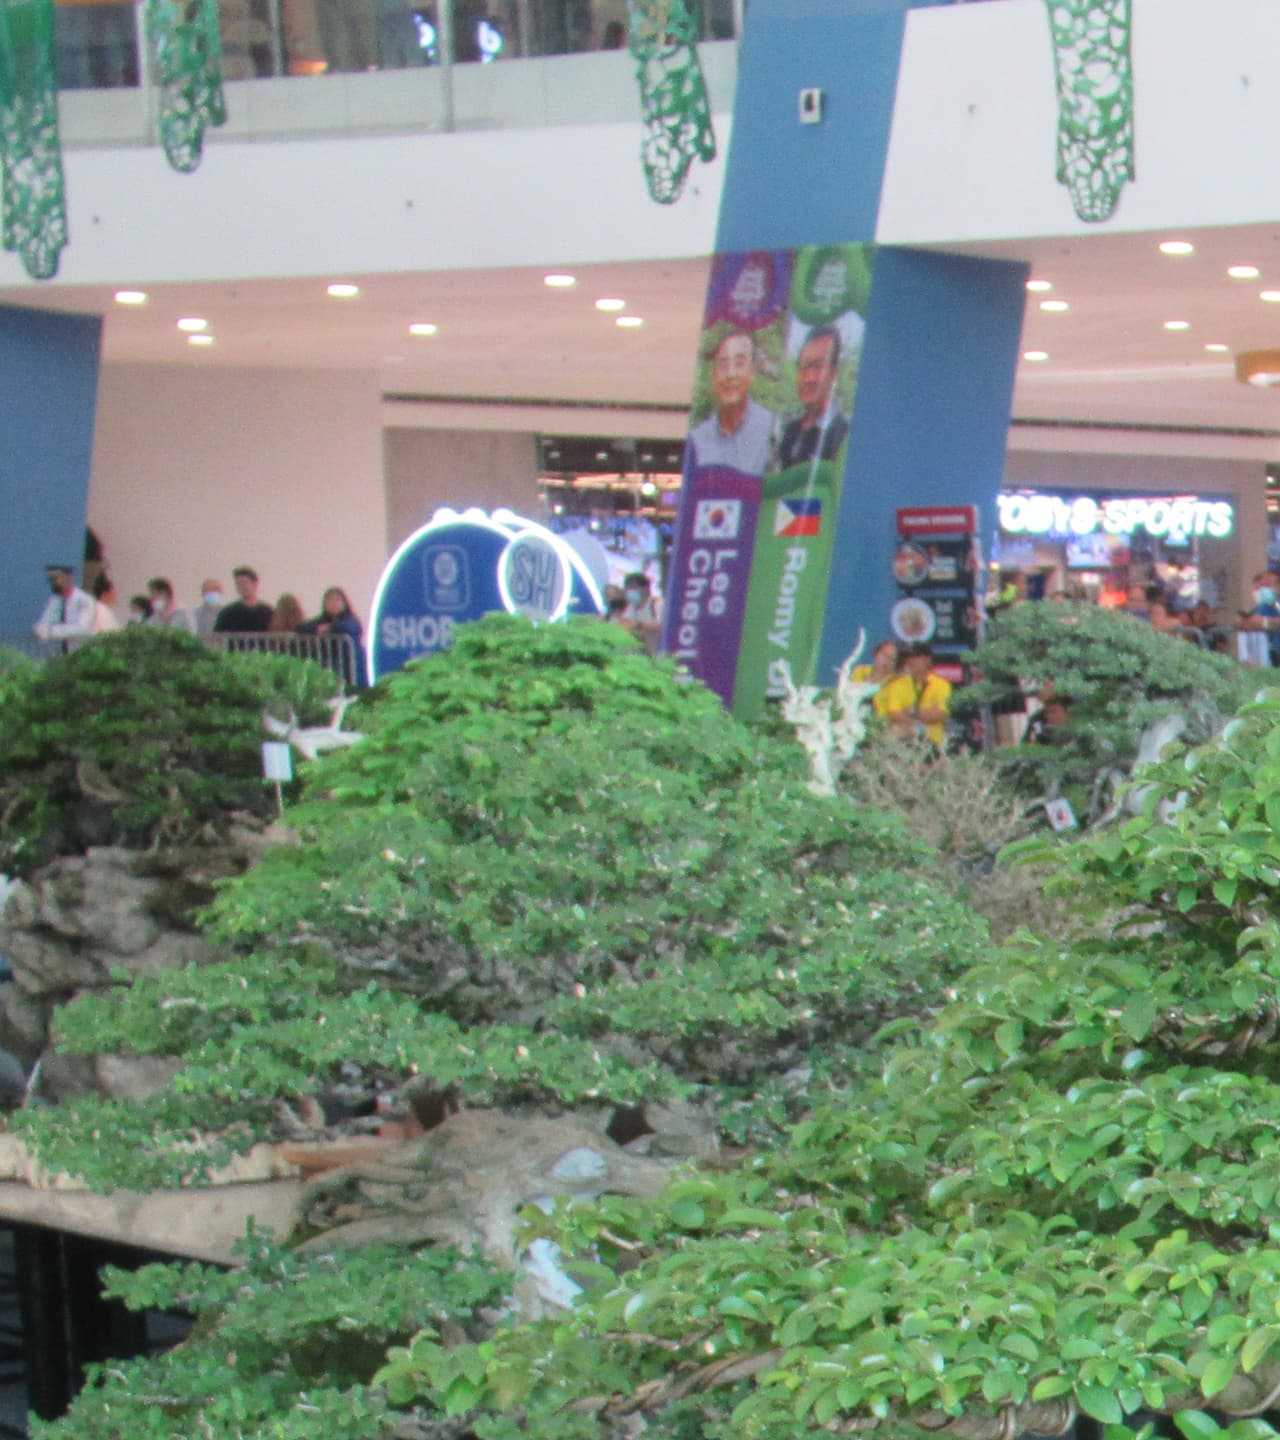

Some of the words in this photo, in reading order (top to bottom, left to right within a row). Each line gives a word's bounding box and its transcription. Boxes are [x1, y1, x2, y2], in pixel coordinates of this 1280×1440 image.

[1102, 499, 1235, 539] SPORTS
[707, 549, 739, 616] Lee
[767, 547, 808, 650] Romy
